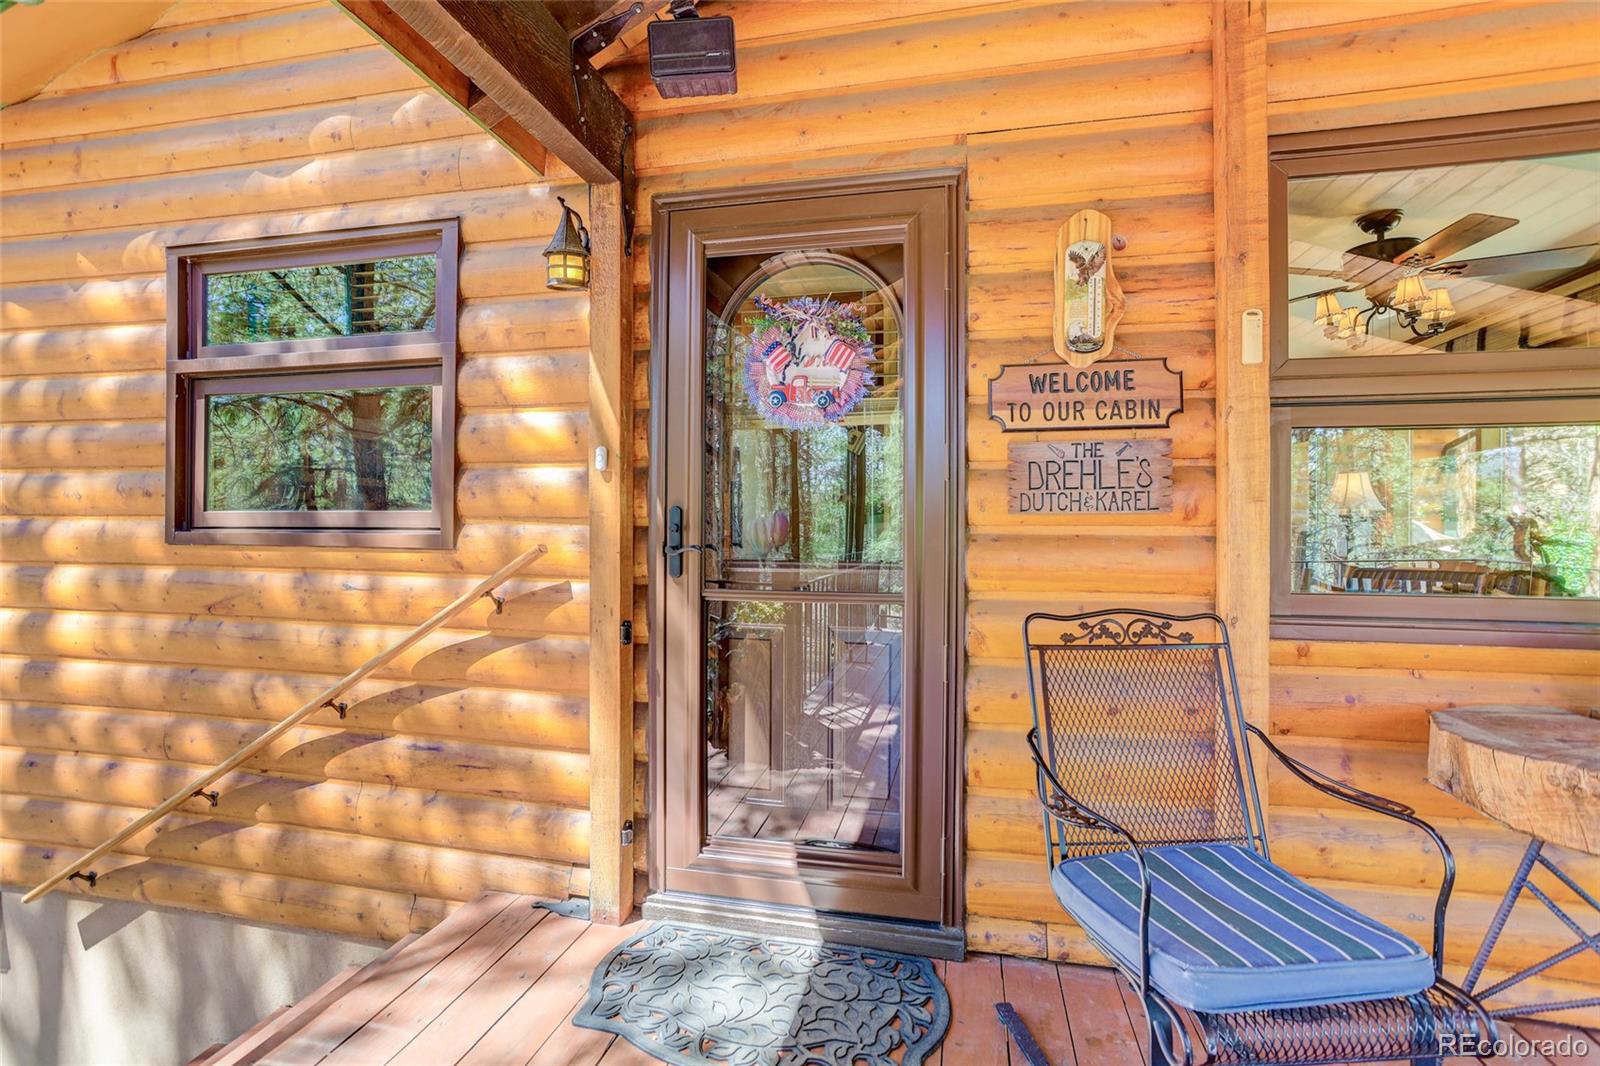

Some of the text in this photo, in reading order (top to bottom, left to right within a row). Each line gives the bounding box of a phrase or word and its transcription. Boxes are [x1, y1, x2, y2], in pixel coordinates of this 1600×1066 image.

[1028, 369, 1137, 394] WELCOME
[1007, 398, 1161, 422] TO OUR CABIN
[1071, 442, 1105, 459] THE
[1027, 456, 1153, 491] DREHLE'S
